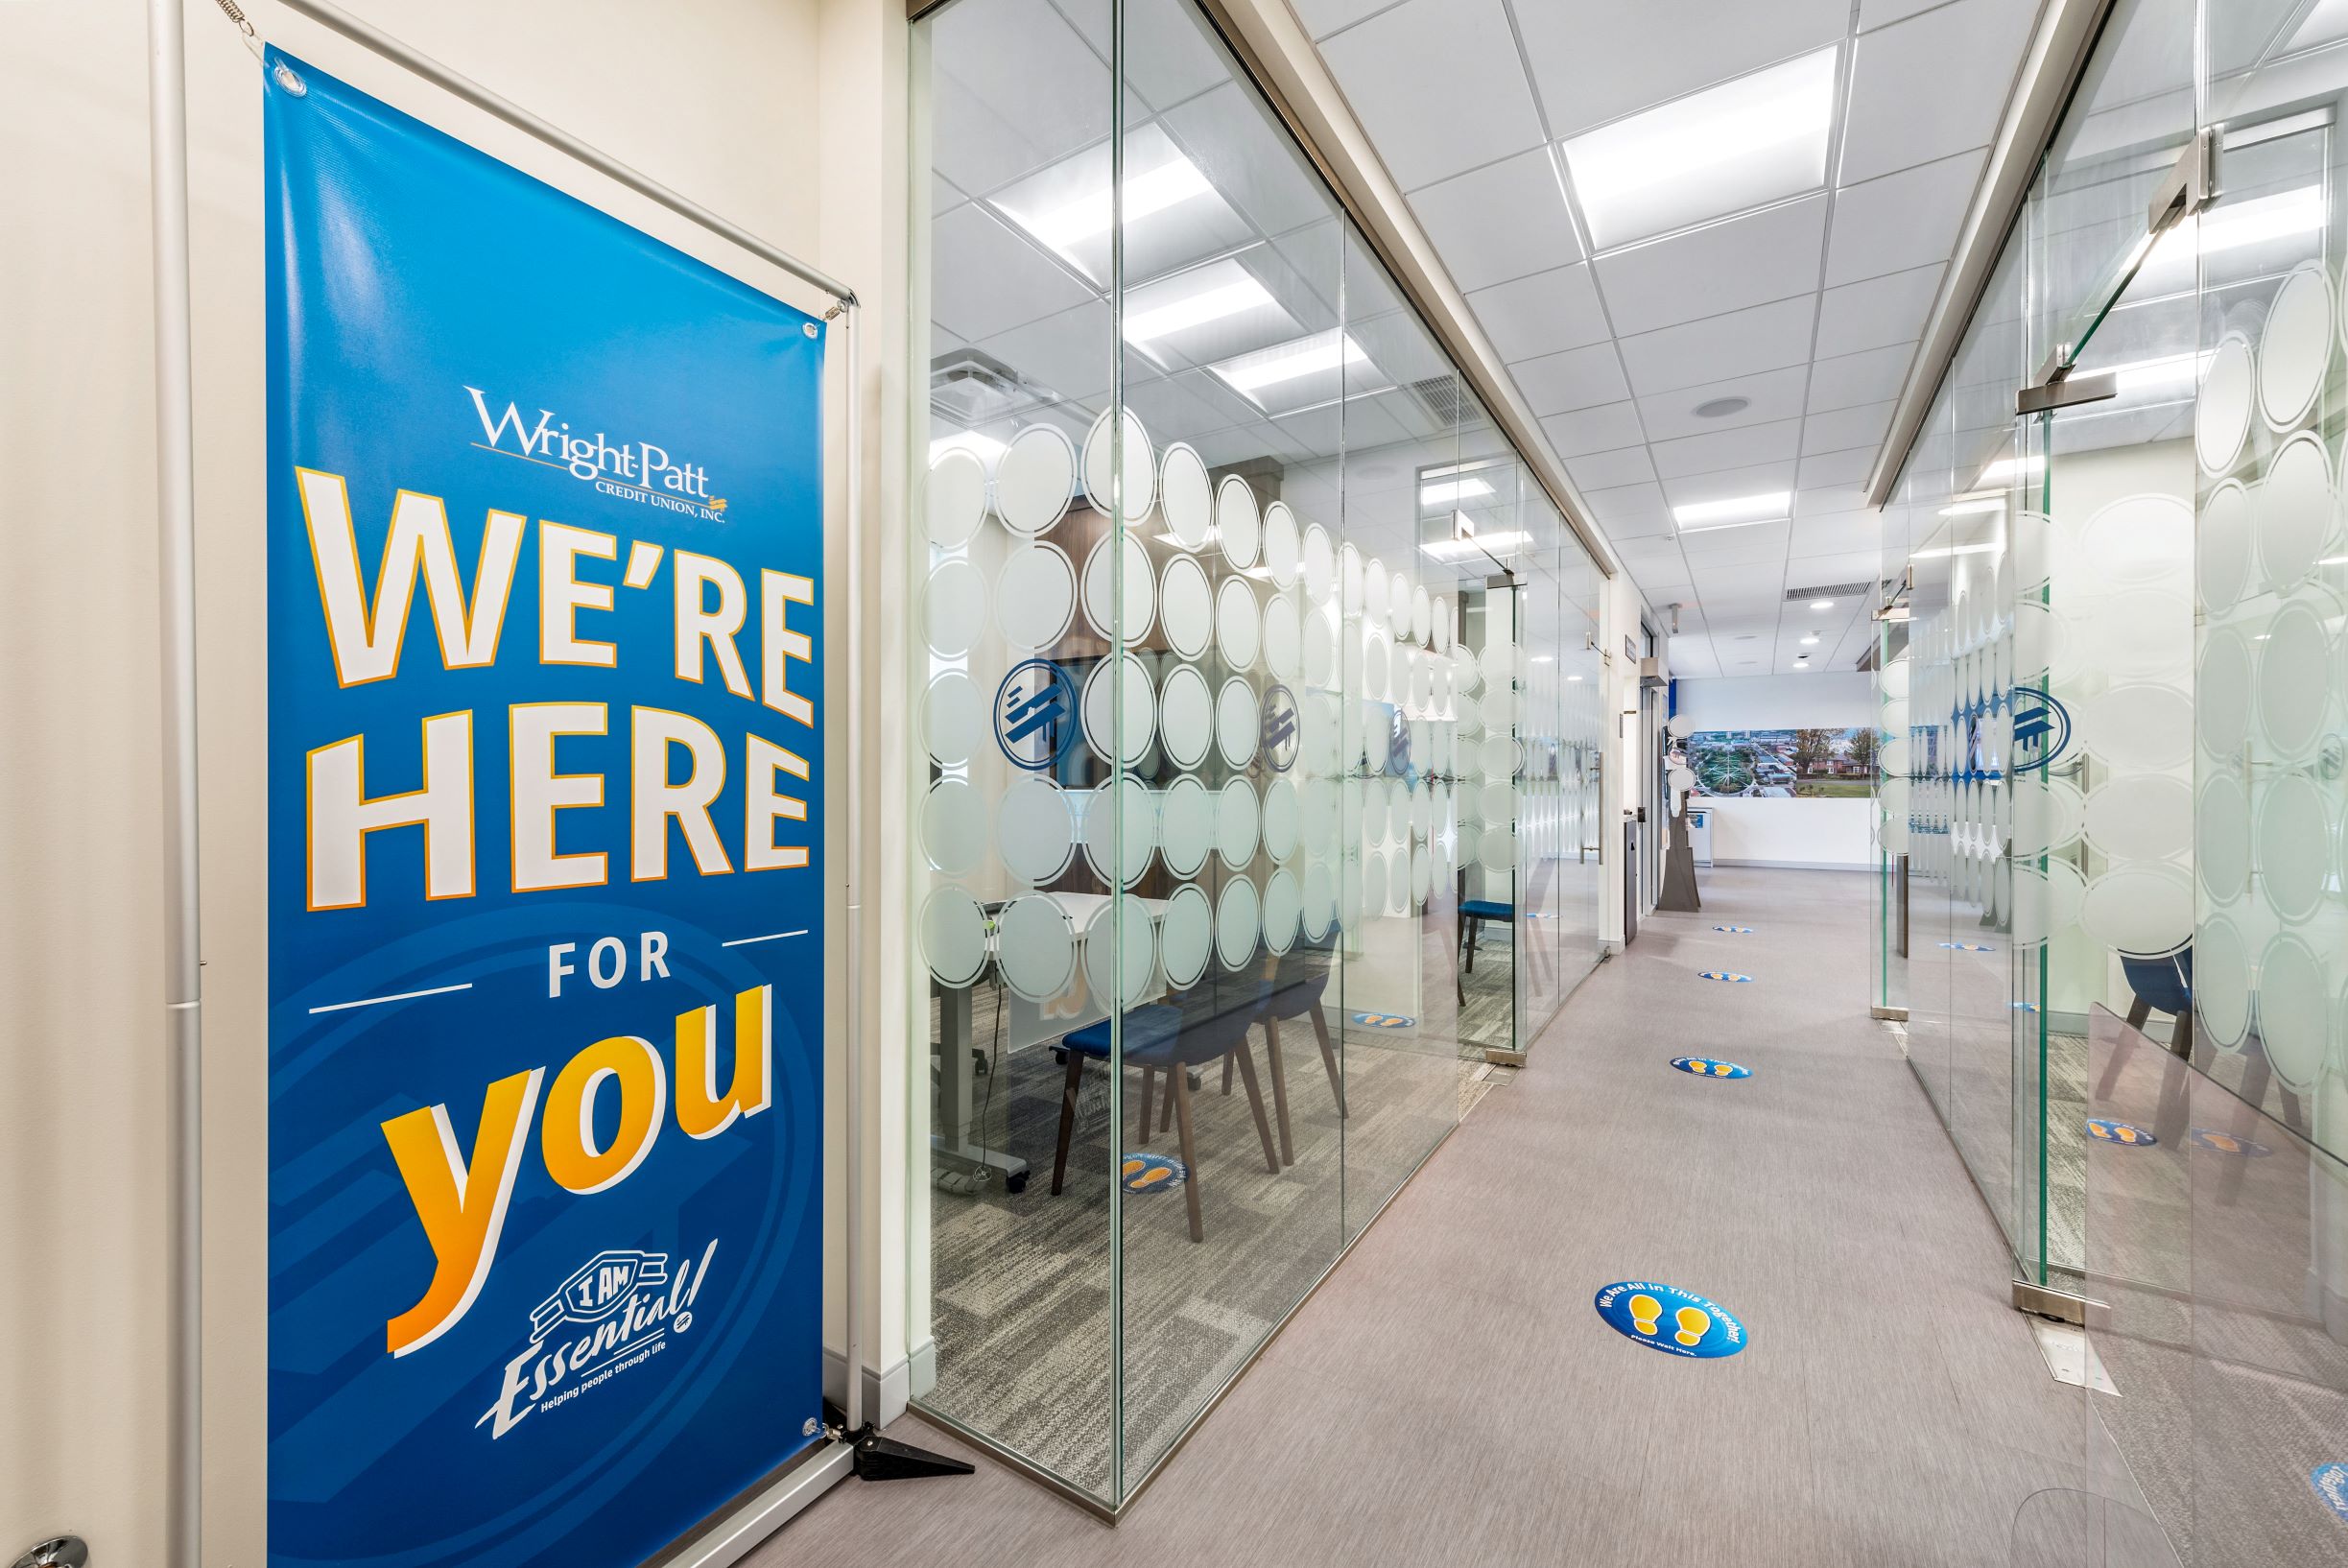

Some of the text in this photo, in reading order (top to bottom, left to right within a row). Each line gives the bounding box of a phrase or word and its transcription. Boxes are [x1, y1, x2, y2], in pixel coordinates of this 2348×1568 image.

[462, 384, 709, 498] Wright-Patt
[595, 481, 726, 524] CREDIT UNION, INC.
[294, 464, 815, 729] WE'RE
[306, 701, 810, 913] HERE
[549, 931, 671, 998] FOR
[380, 983, 772, 1359] you
[578, 1266, 629, 1307] I AM
[1600, 1295, 1613, 1308] We
[1609, 1285, 1627, 1297] Are
[1627, 1282, 1646, 1291] All
[1669, 1287, 1700, 1303] This
[474, 1238, 719, 1440] Essential!
[1656, 1342, 1674, 1351] Wait
[1675, 1346, 1697, 1357] Here.
[540, 1341, 667, 1414] Helping people through life
